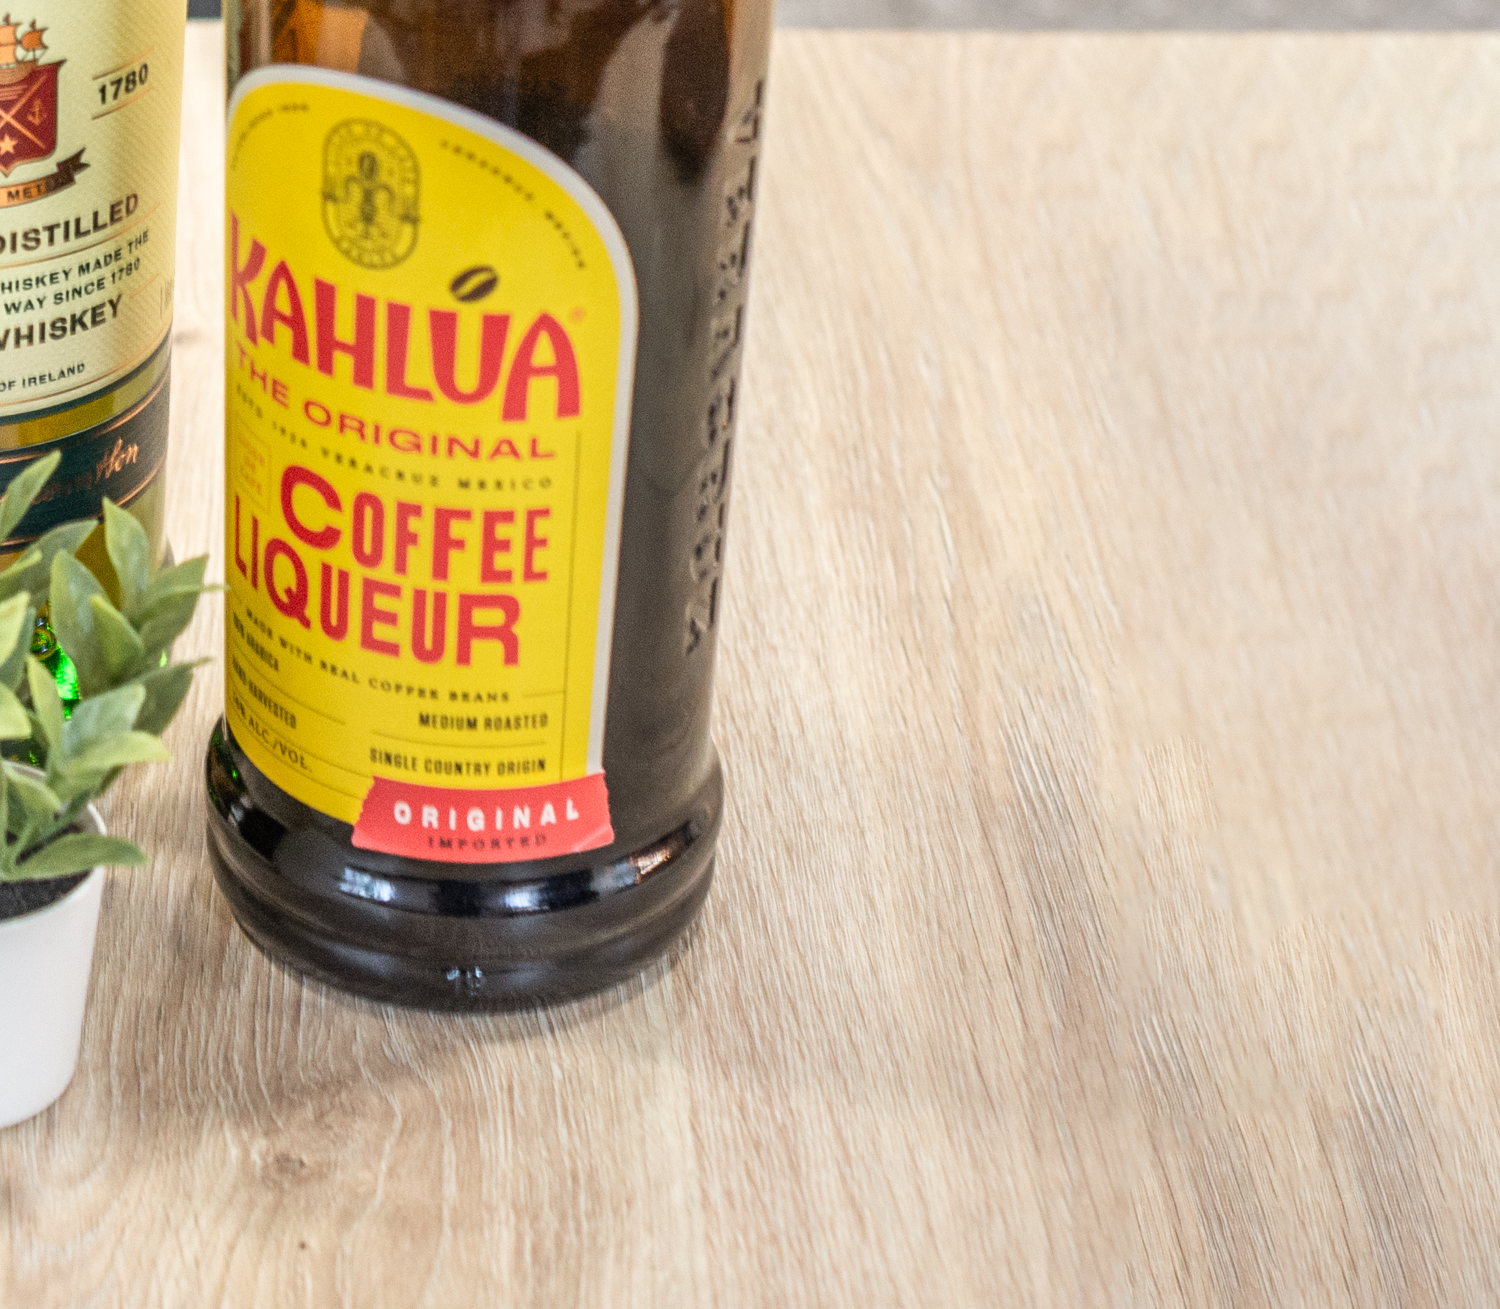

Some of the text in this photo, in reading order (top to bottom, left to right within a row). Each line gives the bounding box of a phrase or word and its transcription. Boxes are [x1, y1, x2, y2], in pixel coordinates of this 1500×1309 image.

[96, 63, 150, 107] 1780
[77, 248, 123, 277] MADE
[127, 229, 150, 256] THE
[4, 295, 48, 317] WAY
[52, 279, 107, 306] SINCE
[110, 256, 142, 286] 1780
[21, 361, 86, 388] IRELAND
[235, 341, 557, 461] THE ORIGINAL
[320, 445, 440, 489] VERACRUZ
[456, 475, 553, 492] MEXICO
[280, 464, 553, 585] COFFEE
[233, 493, 522, 668] LIQUEUR
[278, 635, 313, 666] WITH
[319, 659, 360, 685] REAL
[448, 689, 511, 704] BEANS
[418, 711, 548, 731] MEDIUM ROASTED
[369, 747, 547, 776] SINGLE COUNTRY ORIGIN
[393, 796, 580, 832] ORIGINAL
[428, 833, 548, 851] IMPORTED
